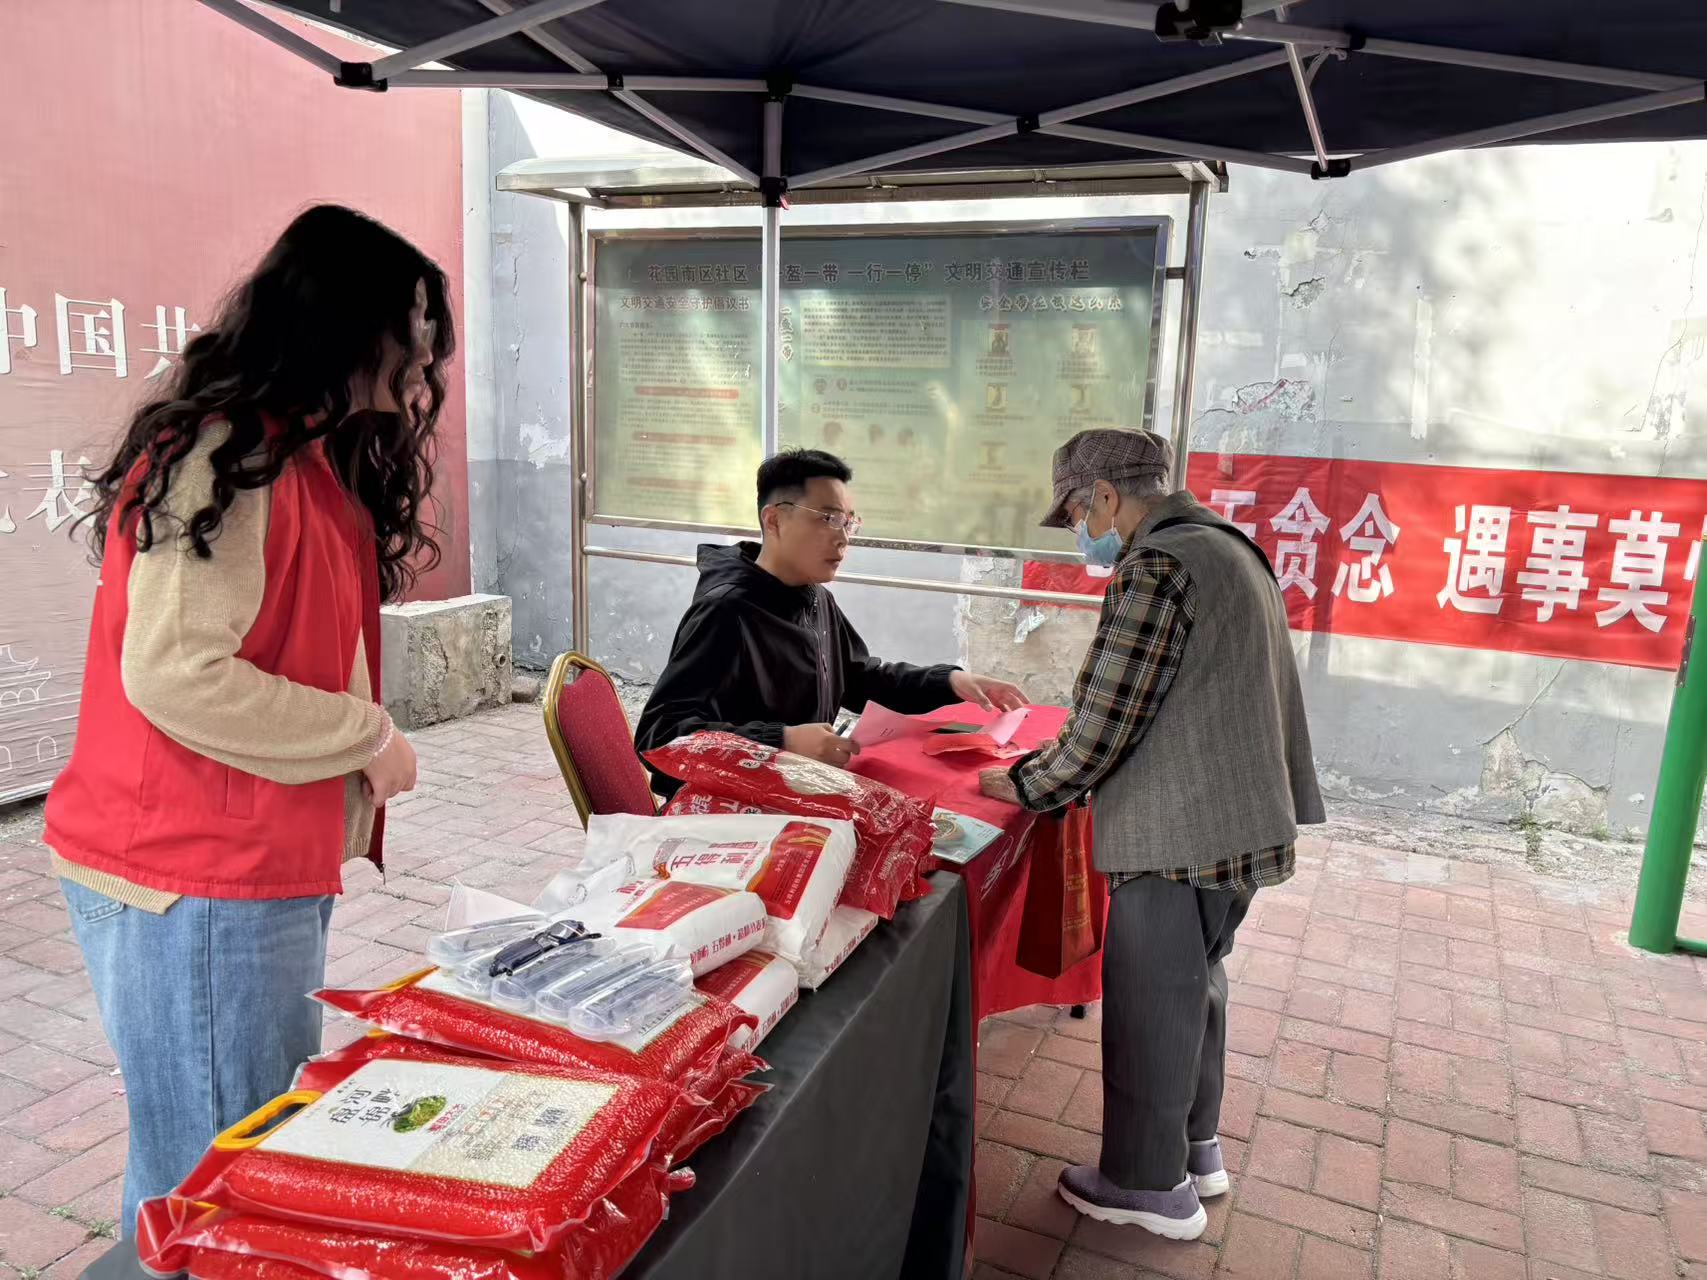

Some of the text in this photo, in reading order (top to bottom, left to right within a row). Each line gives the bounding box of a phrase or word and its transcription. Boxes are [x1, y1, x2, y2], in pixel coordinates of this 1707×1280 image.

[0, 450, 97, 533] 表
[1436, 504, 1701, 633] 遇事莫
